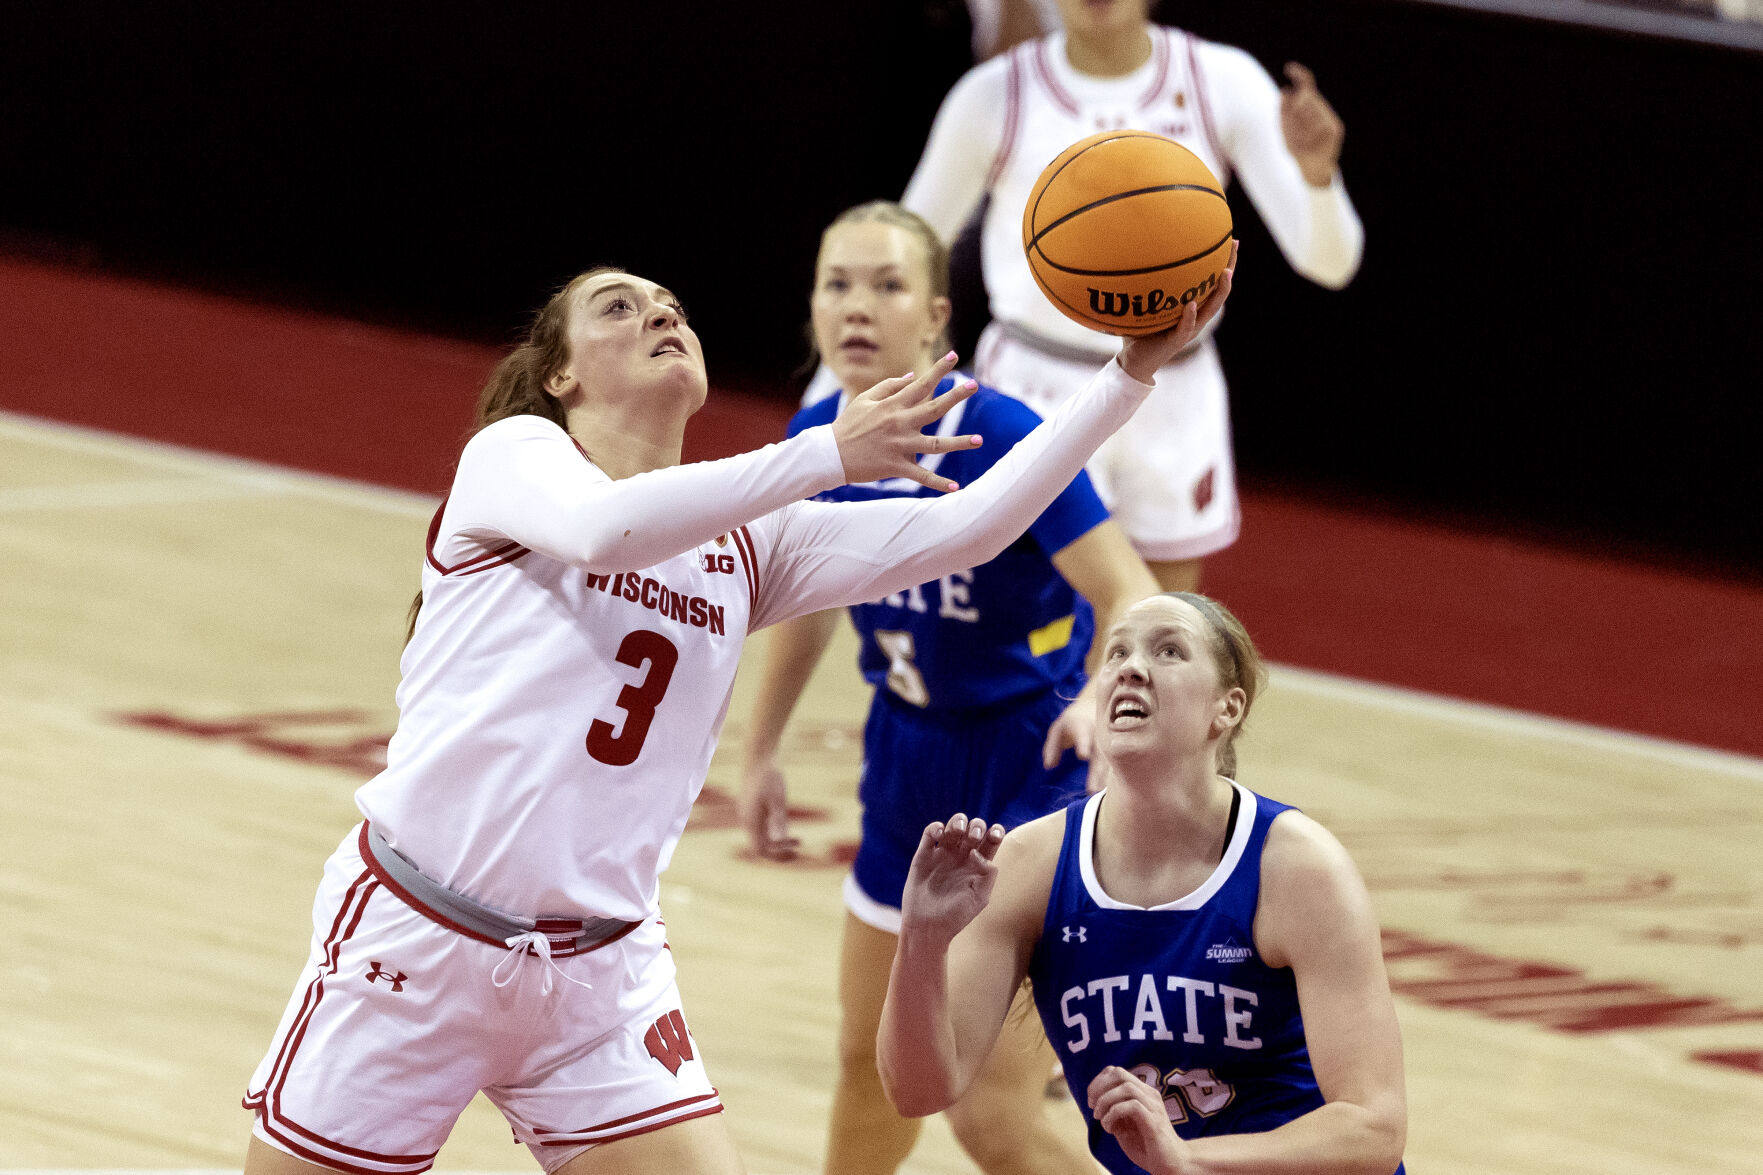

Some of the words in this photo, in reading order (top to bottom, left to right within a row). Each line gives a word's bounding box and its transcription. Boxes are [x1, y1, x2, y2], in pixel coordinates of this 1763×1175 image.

[1086, 272, 1216, 317] Wilson
[585, 629, 679, 767] 3
[1060, 973, 1263, 1054] STATE
